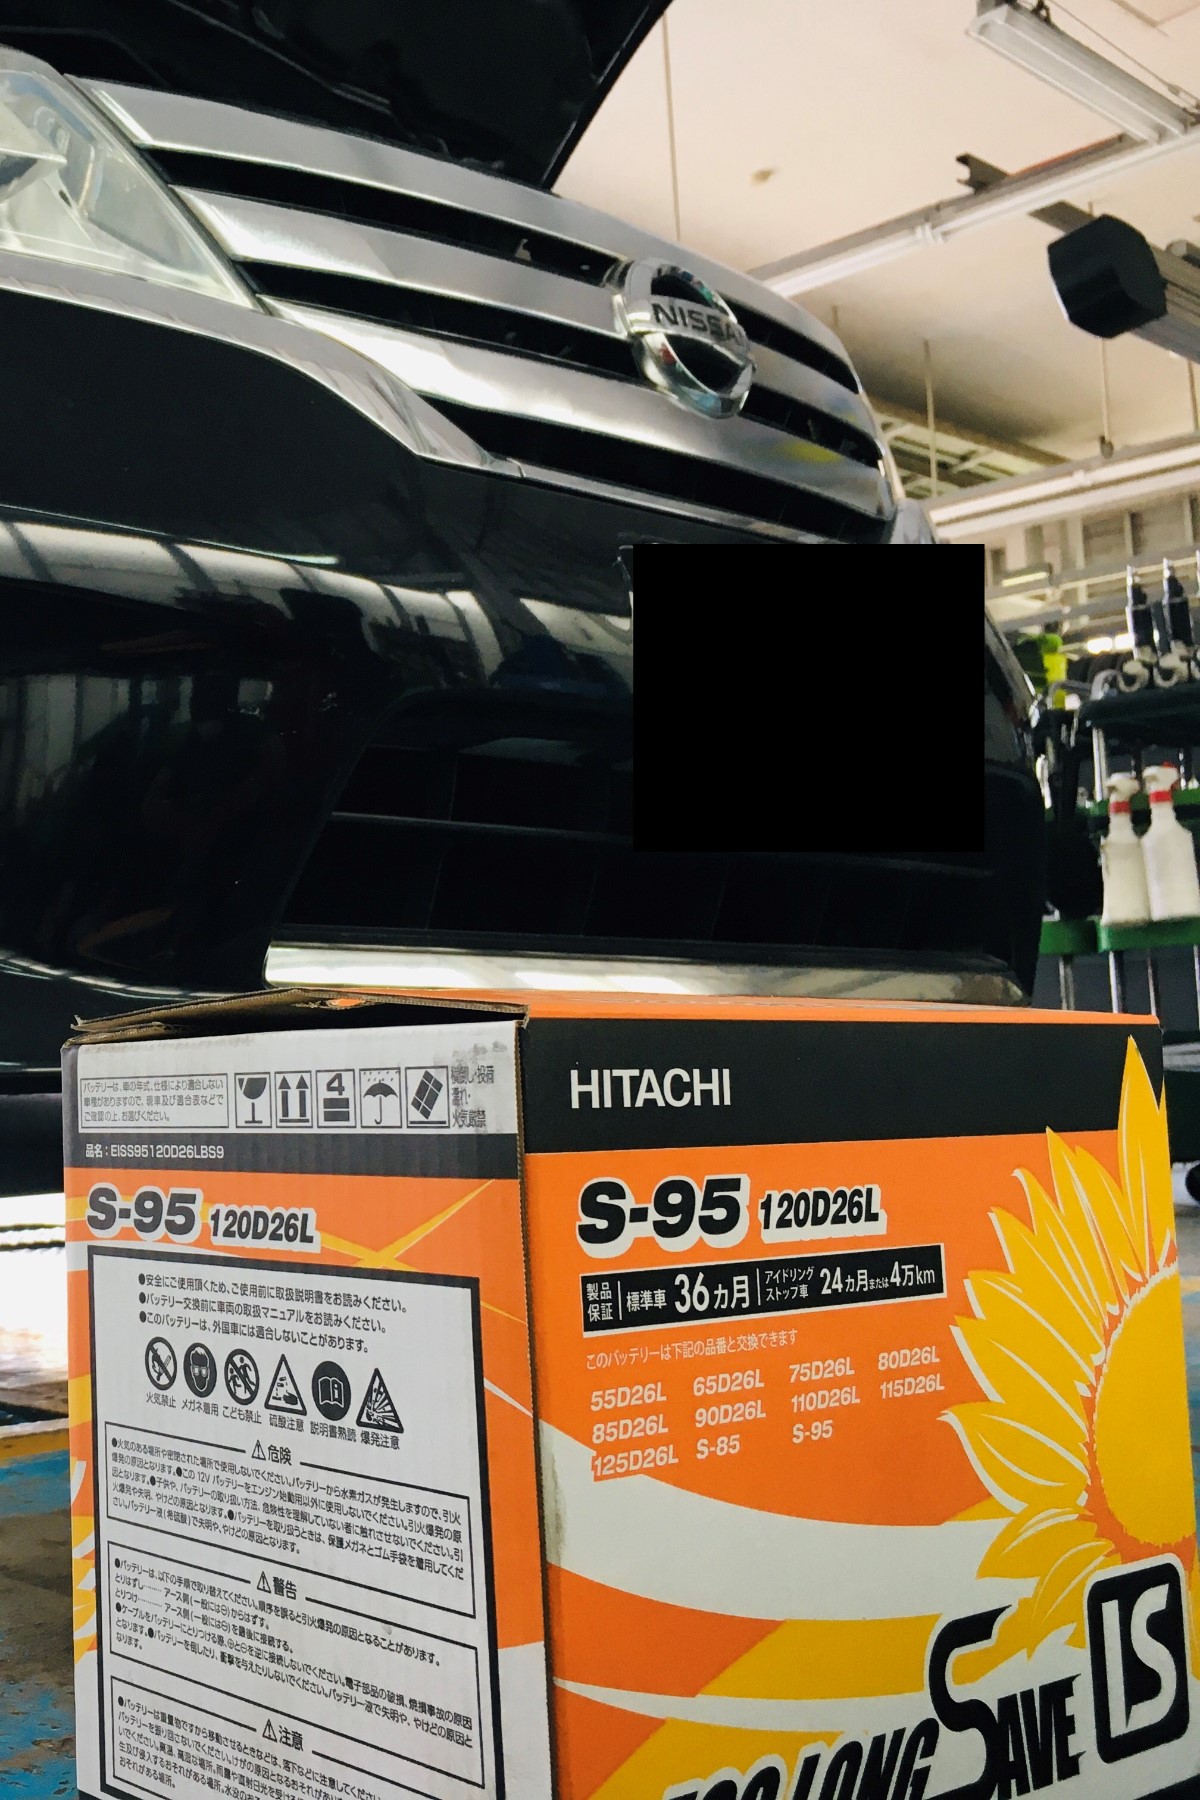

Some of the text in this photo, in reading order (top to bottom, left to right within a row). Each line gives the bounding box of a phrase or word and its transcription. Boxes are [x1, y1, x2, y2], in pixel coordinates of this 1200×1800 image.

[652, 302, 746, 346] NISSA
[326, 1072, 345, 1096] 4
[571, 1068, 731, 1109] HITACHI
[87, 1187, 315, 1244] S-95 120D26L
[578, 1178, 879, 1244] S-95 120D26L
[764, 1266, 815, 1285] アイドリング
[586, 1281, 612, 1301] 製品
[626, 1289, 667, 1313] 標準車
[765, 1284, 809, 1301] ストップ車
[587, 1303, 613, 1322] 保証
[586, 1328, 798, 1370] このバッテリーは下記の品番と交換できます
[589, 1345, 940, 1412] 55D26L 65D26L 75D26L 80D26L
[146, 1392, 400, 1450] 火気禁止 メガネ着用 こども禁止 硫酸注意 説明書熟読 爆発注意
[592, 1373, 945, 1445] 85D26L 90D26L 110D26L 115D26L
[268, 1444, 292, 1466] 危険
[594, 1419, 833, 1477] 125D26L S-85 S-95
[198, 1472, 210, 1483] 12V
[273, 1576, 297, 1600] 警告
[116, 1632, 142, 1650] なります。
[925, 1604, 1086, 1800] SAVE
[1101, 1583, 1177, 1738] IS
[279, 1725, 303, 1751] 注意
